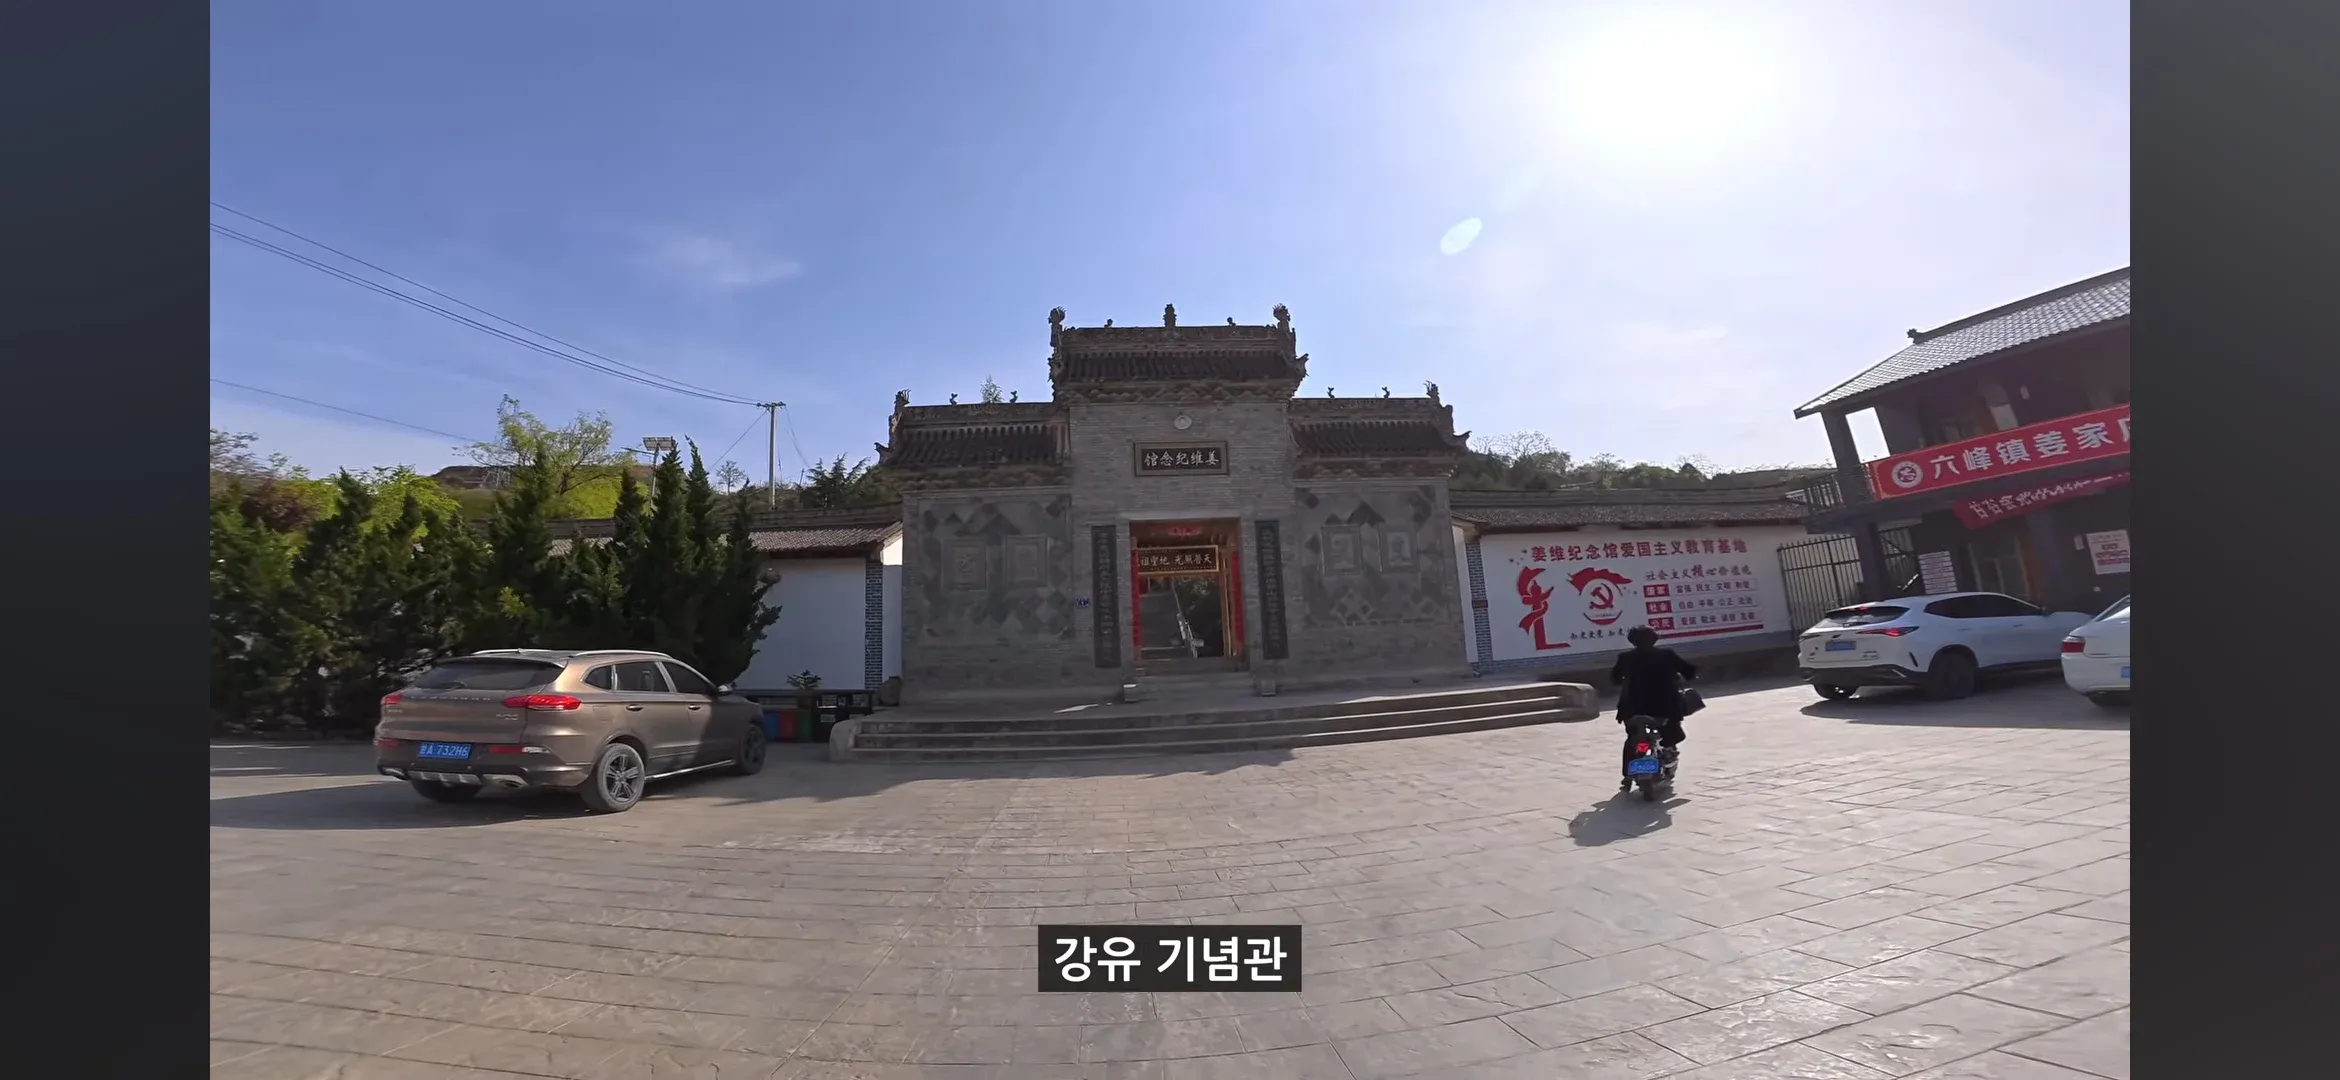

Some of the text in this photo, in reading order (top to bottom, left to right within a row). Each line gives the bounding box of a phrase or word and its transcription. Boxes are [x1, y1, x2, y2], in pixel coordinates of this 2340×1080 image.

[1532, 539, 1747, 562] 姜维纪念馆爱国主义教育基地
